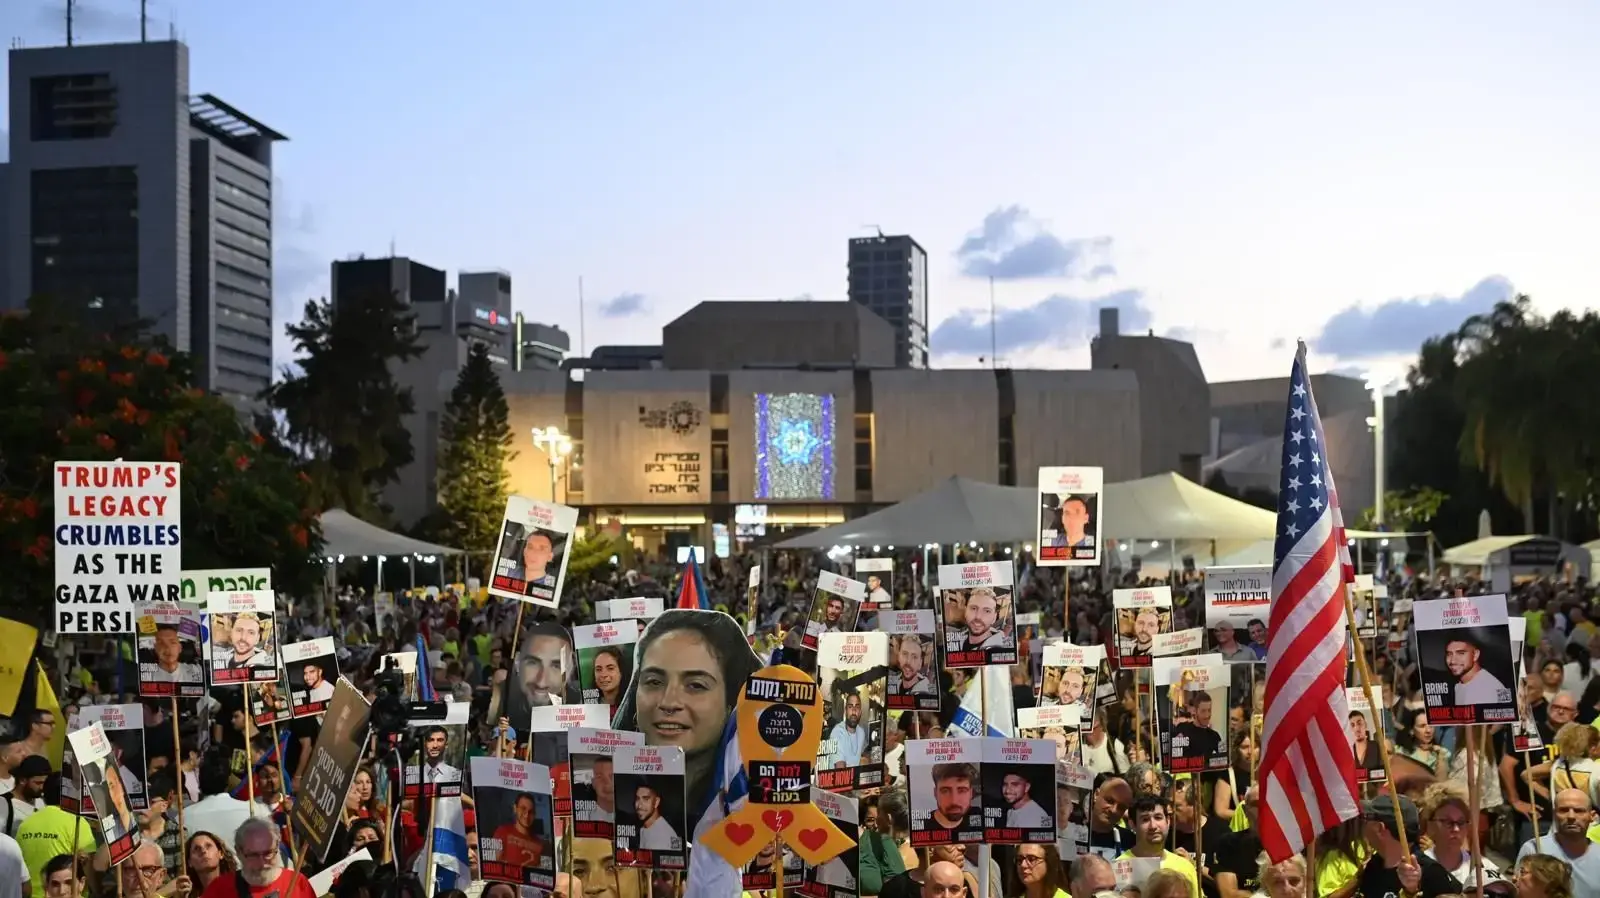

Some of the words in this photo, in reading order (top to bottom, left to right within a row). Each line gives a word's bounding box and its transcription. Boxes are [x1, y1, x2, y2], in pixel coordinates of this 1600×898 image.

[57, 466, 177, 488] TRUMP'S
[678, 474, 699, 482] בית
[68, 496, 168, 517] LEGACY
[56, 525, 180, 546] CRUMBLES
[73, 554, 104, 574] AS
[115, 554, 162, 574] THE
[56, 584, 118, 604] GAZA
[128, 584, 180, 602] WAR
[59, 612, 132, 632] PERSI
[1425, 683, 1448, 694] BRING
[1427, 695, 1443, 706] HIM
[765, 727, 795, 735] הביתה
[317, 746, 335, 776] חטוף
[760, 765, 775, 776] הם
[778, 764, 800, 776] למה
[331, 765, 345, 789] אין
[317, 784, 336, 816] סוג
[773, 792, 800, 802] בעזה
[575, 800, 596, 810] BRING
[912, 808, 931, 820] BRING
[617, 825, 636, 836] BRING
[481, 838, 503, 850] BRING
[617, 837, 629, 848] HIM
[482, 850, 497, 861] HIM
